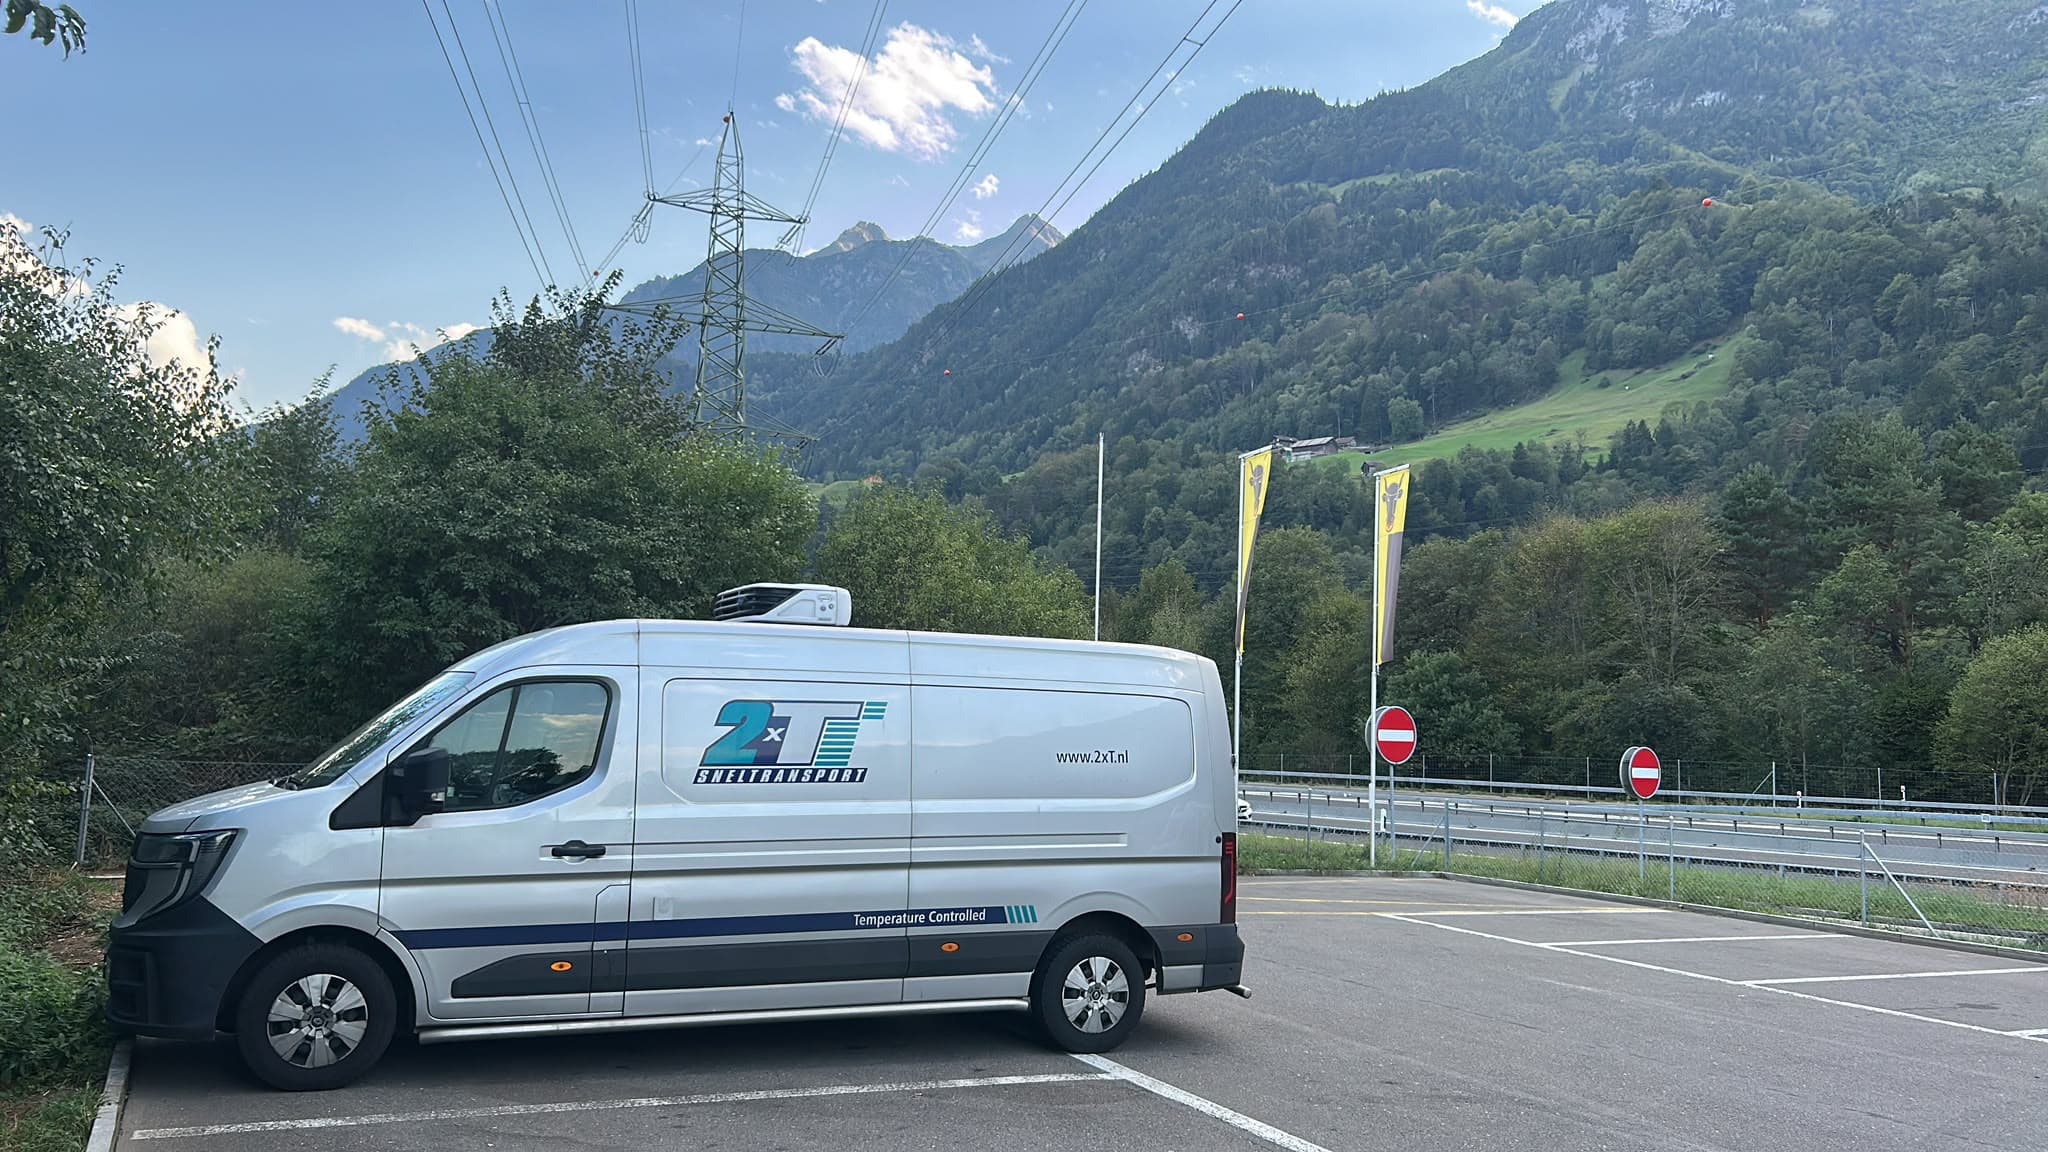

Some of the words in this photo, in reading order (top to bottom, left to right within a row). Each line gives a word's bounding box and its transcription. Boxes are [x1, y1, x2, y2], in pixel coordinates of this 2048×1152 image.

[1056, 749, 1128, 763] www.2xT.nl
[696, 768, 865, 783] SNELTRANSPORT
[853, 911, 926, 928] Temperature
[928, 908, 986, 923] Controlled
